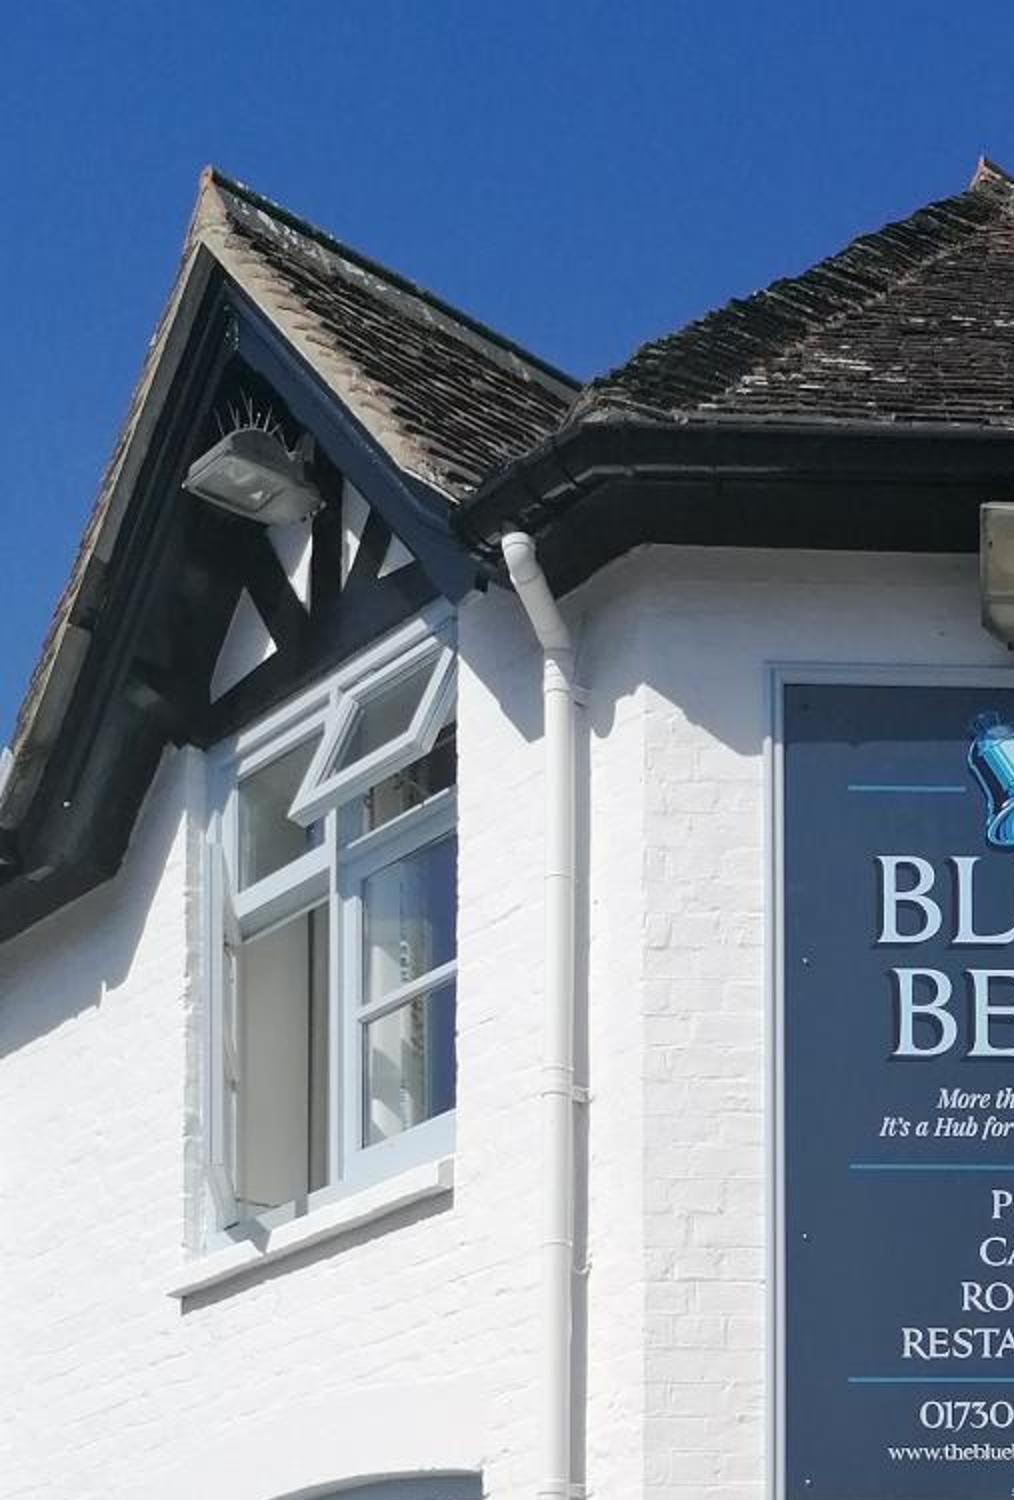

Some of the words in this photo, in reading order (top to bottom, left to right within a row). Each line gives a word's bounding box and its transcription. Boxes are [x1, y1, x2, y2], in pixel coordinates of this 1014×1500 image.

[936, 1087, 991, 1109] More
[880, 1117, 912, 1137] It's
[915, 1121, 929, 1137] a
[933, 1117, 979, 1137] Hub
[981, 1117, 1014, 1140] for
